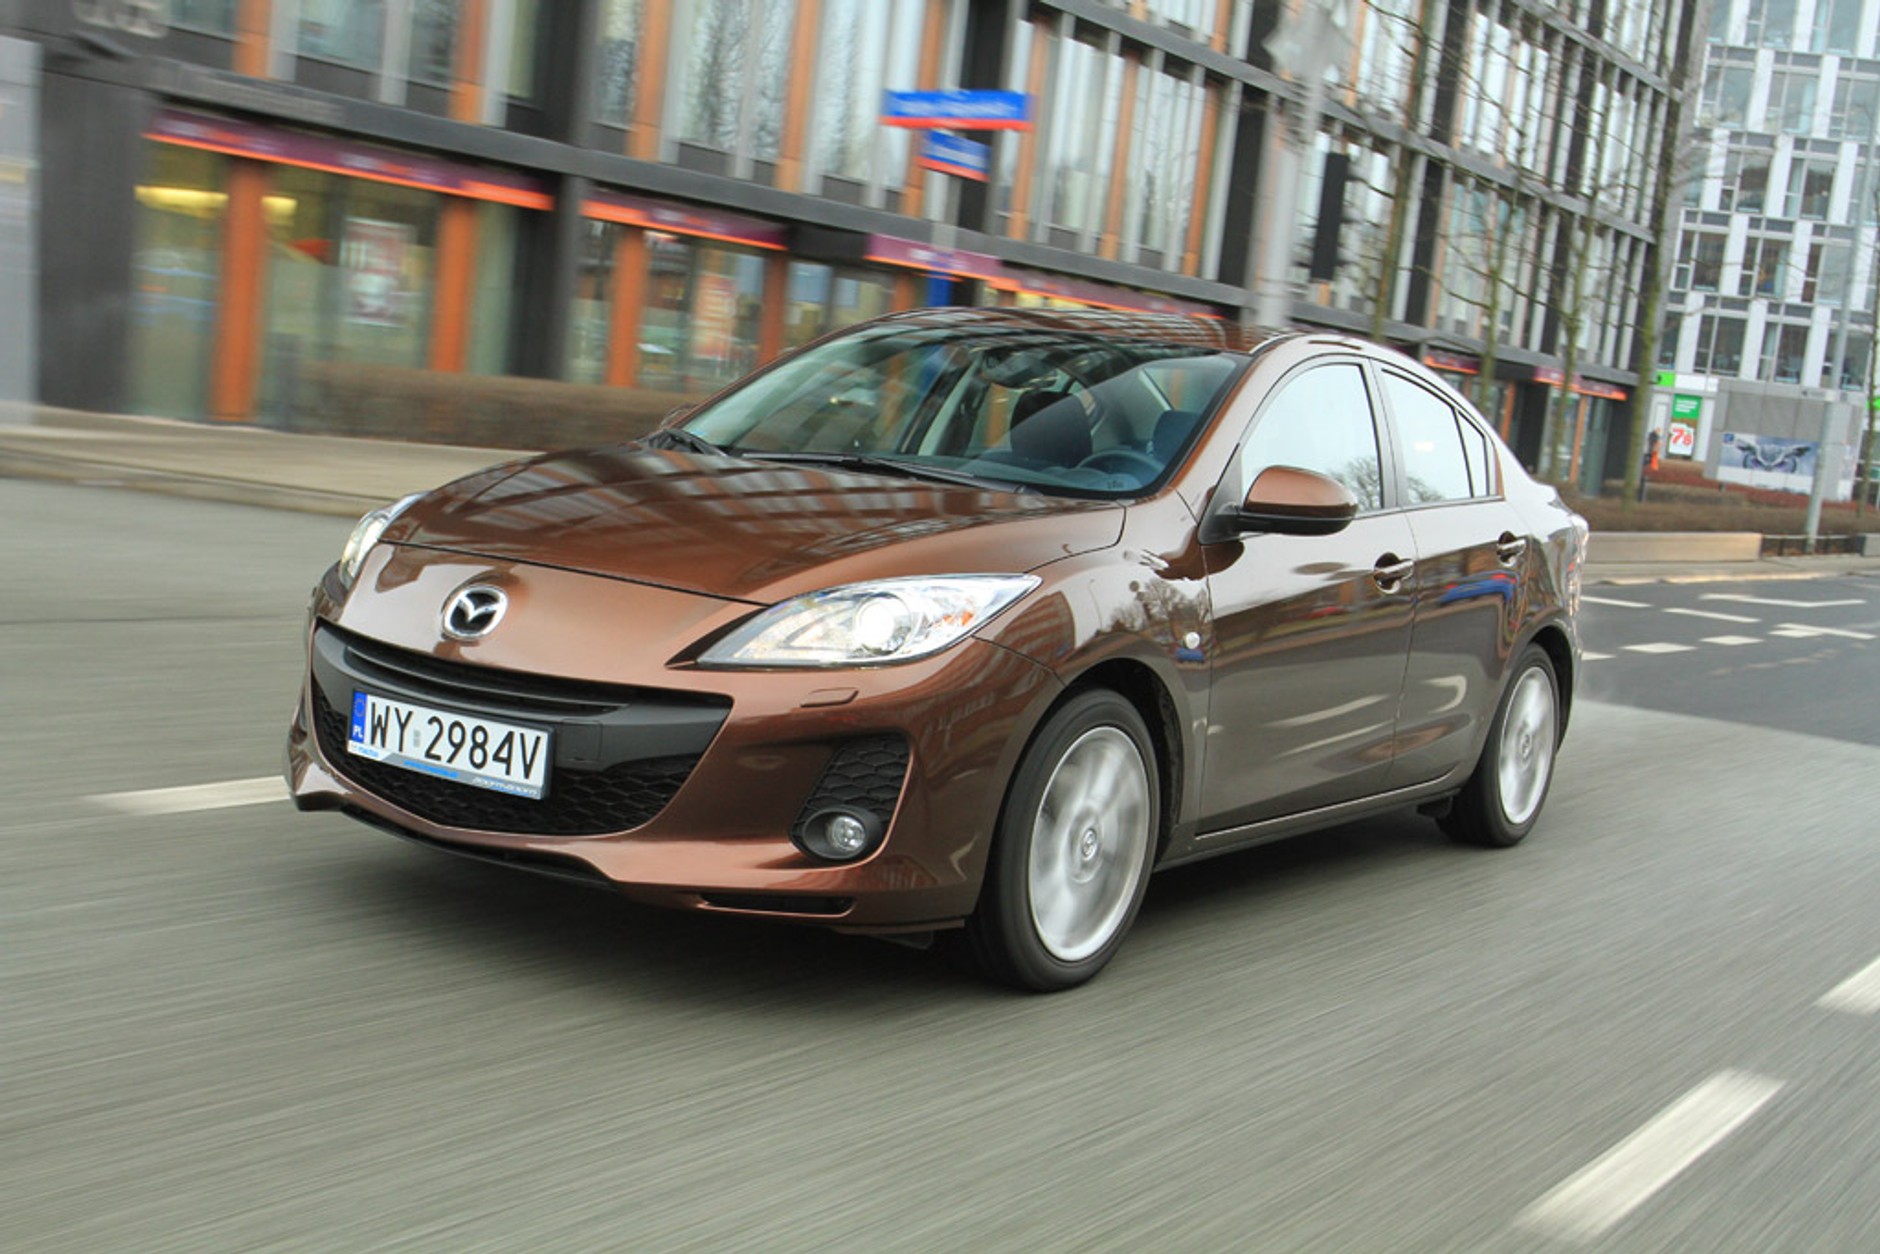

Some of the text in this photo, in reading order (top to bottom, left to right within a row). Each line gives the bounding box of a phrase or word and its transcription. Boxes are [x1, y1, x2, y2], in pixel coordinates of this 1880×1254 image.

[352, 724, 364, 739] PL
[370, 702, 542, 780] WY 2984V
